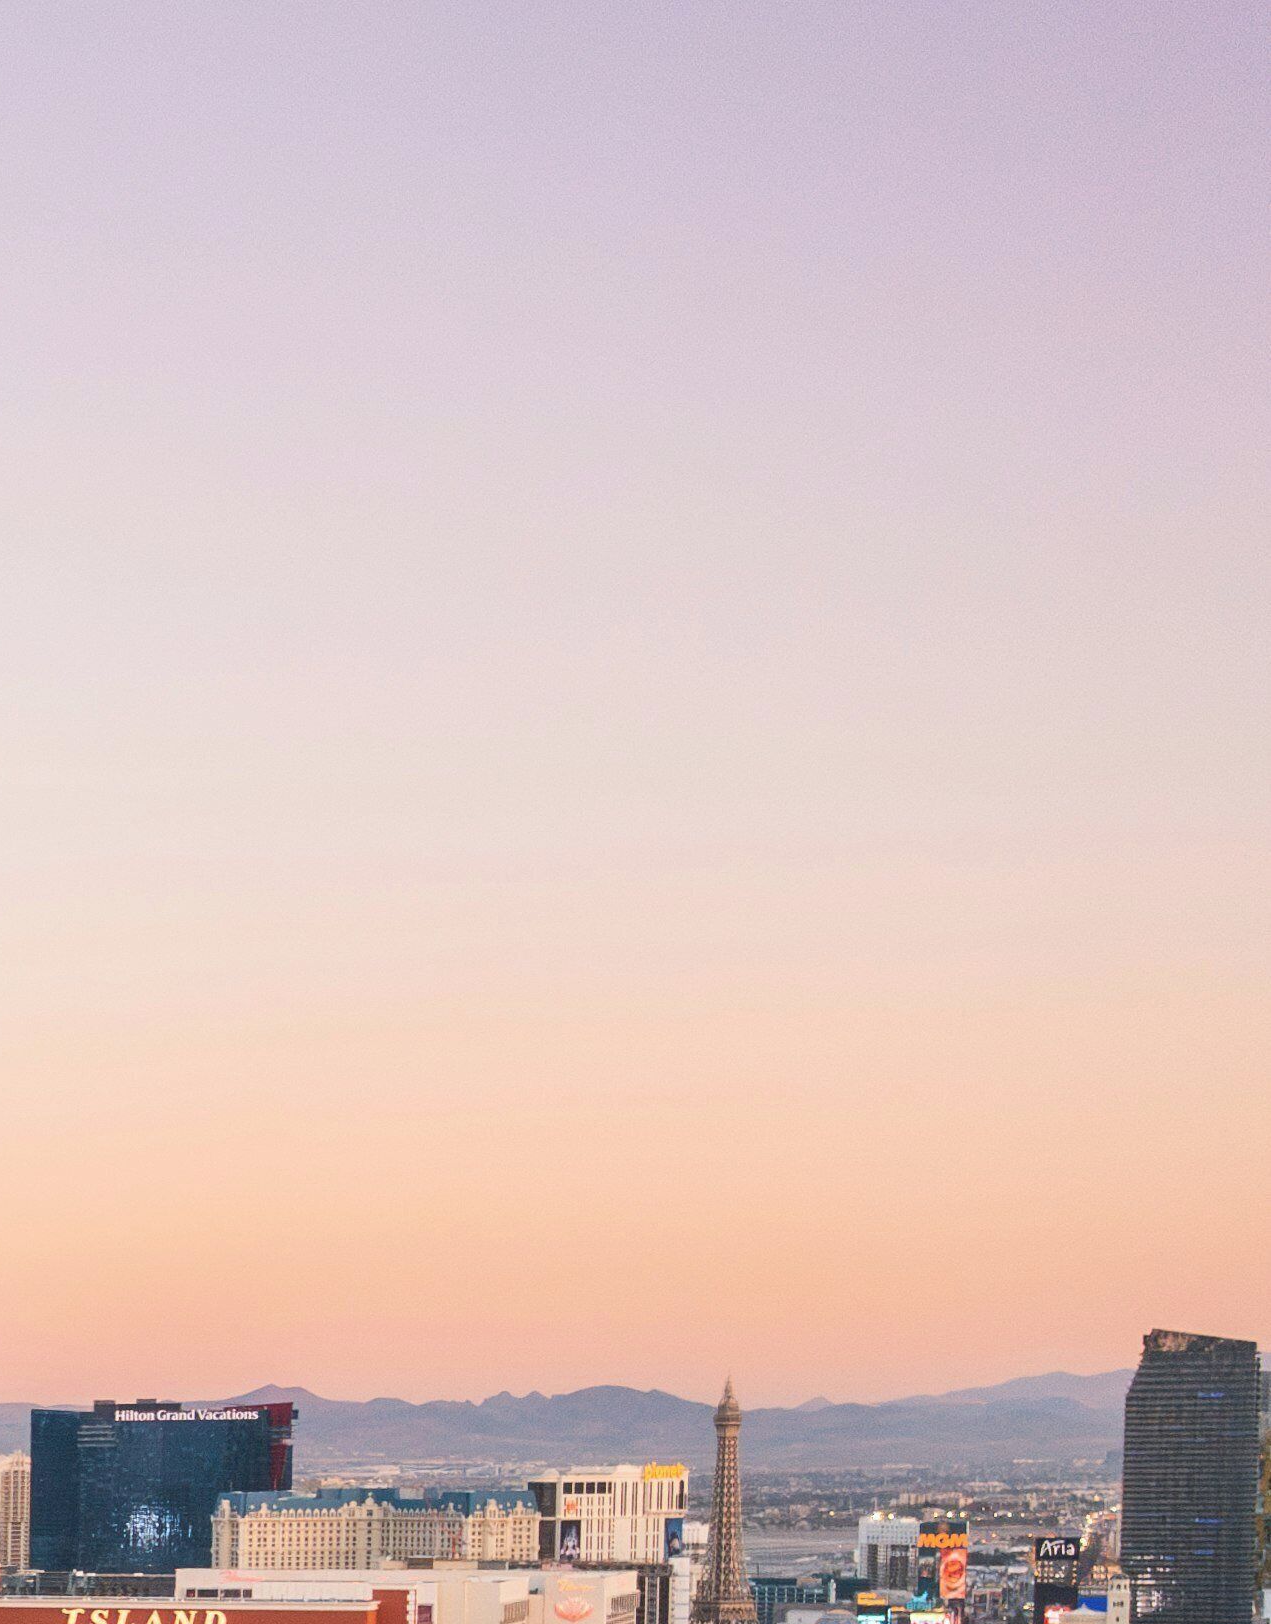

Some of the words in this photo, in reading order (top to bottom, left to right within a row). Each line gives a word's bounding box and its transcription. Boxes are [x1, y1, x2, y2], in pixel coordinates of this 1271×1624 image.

[114, 1410, 156, 1421] Hilton
[157, 1409, 196, 1421] Grand
[196, 1408, 259, 1420] Vacations
[917, 1533, 970, 1549] MGM
[1040, 1540, 1075, 1557] Aria
